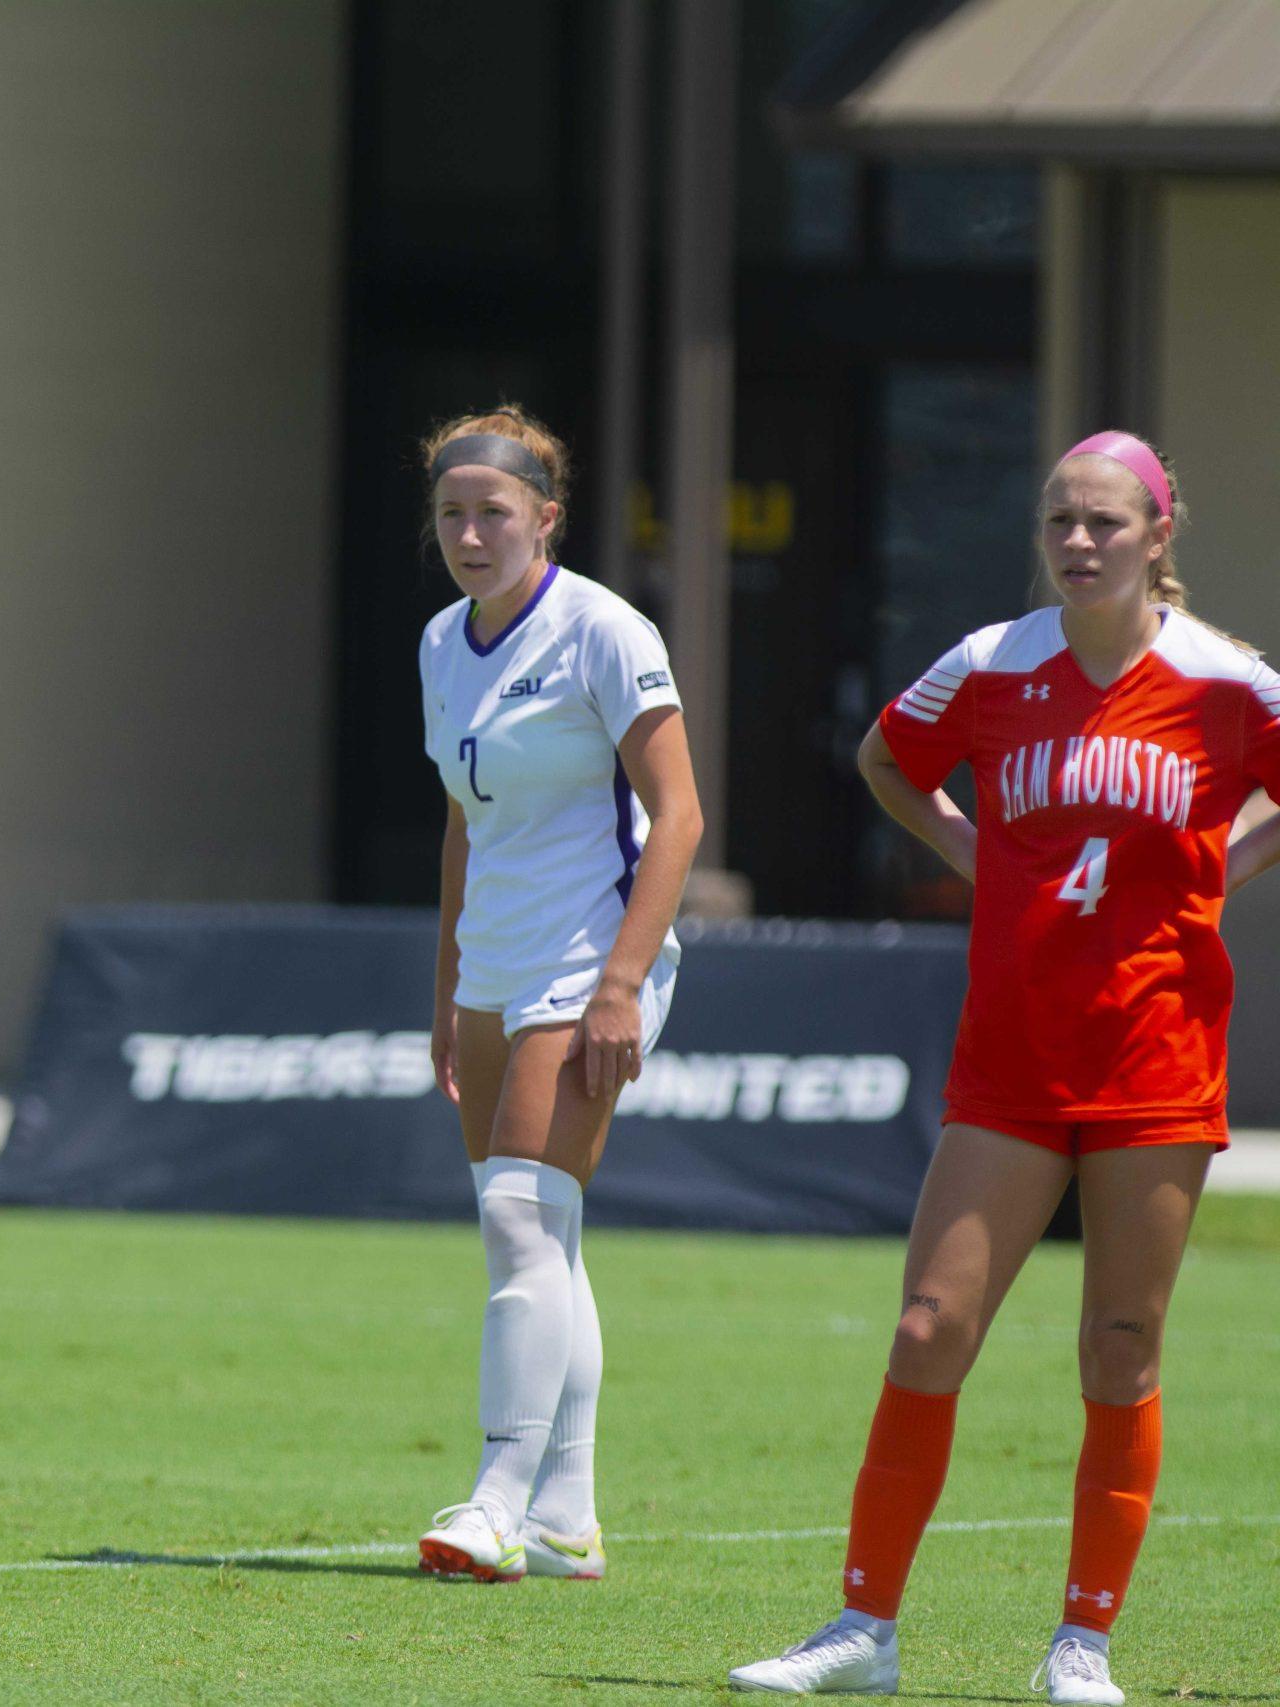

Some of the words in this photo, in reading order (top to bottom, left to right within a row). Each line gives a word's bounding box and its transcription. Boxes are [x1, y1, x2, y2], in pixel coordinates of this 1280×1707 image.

[499, 678, 542, 699] LSU
[459, 736, 494, 802] 2
[1000, 739, 1054, 824] SAM
[1061, 736, 1197, 833] HOUSTON
[1056, 837, 1110, 917] 4
[123, 1031, 434, 1101] TIGERS
